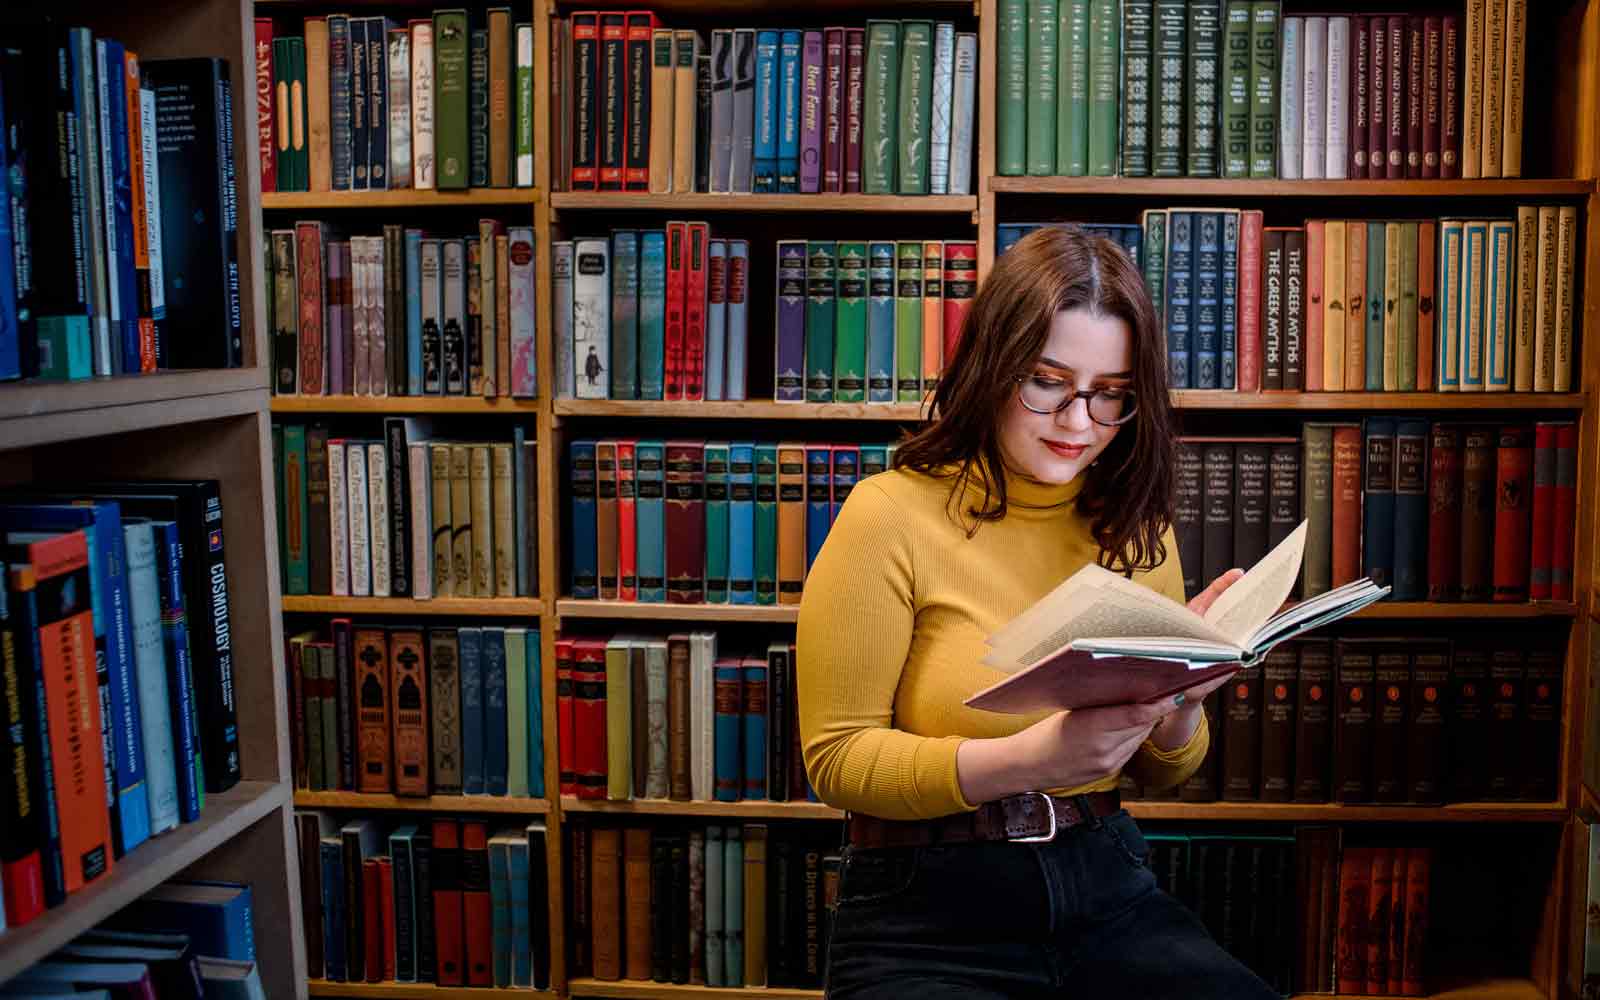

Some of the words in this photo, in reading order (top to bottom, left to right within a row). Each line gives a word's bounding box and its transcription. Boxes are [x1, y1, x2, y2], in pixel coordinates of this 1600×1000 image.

[1471, 2, 1482, 53] Byzantine
[1490, 1, 1500, 28] Early
[1231, 32, 1248, 71] 1914
[1256, 32, 1274, 71] 1917
[1358, 31, 1367, 72] MARVELS
[1374, 30, 1384, 66] HEROES
[1392, 30, 1401, 67] HISTORY
[1446, 30, 1456, 67] HISTORY
[353, 75, 364, 94] and
[370, 75, 382, 94] and
[786, 62, 794, 77] The
[807, 64, 820, 92] Brat
[829, 65, 839, 80] The
[850, 66, 860, 80] The
[1358, 73, 1367, 94] AND
[1374, 67, 1384, 89] AND
[1392, 69, 1401, 89] AND
[1411, 73, 1421, 94] AND
[1429, 67, 1439, 88] AND
[1446, 69, 1456, 89] AND
[1471, 73, 1480, 94] and
[1512, 59, 1521, 77] and
[256, 60, 271, 157] MOZART
[829, 81, 839, 114] Daughter
[850, 81, 860, 115] Daughter
[1358, 96, 1367, 127] MAGIC
[1374, 89, 1384, 123] SAINTS
[1392, 91, 1401, 137] ROMANCE
[1411, 96, 1421, 127] MAGIC
[1446, 91, 1456, 136] ROMANCE
[829, 126, 839, 144] Time
[850, 126, 860, 144] Time
[1231, 113, 1248, 154] 1916
[1256, 113, 1274, 154] 1919
[228, 180, 237, 232] UNIVERSE
[72, 215, 82, 258] Quantum
[1543, 216, 1554, 241] Early
[1562, 216, 1574, 266] Byzantine
[229, 263, 238, 290] SETH
[1268, 249, 1280, 274] THE
[1288, 249, 1300, 275] THE
[1544, 243, 1554, 286] Medieval
[1268, 277, 1280, 316] GREEK
[1288, 277, 1300, 315] GREEK
[1523, 273, 1532, 290] and
[1561, 289, 1570, 307] and
[231, 294, 240, 328] LLOYD
[1268, 317, 1280, 362] MYTHS
[1288, 317, 1300, 363] MYTHS
[1268, 368, 1280, 377] II
[210, 563, 231, 652] COSMOLOGY
[115, 608, 125, 663] PRIMORDIAL
[61, 623, 74, 683] Modern
[120, 666, 130, 704] DENSITY
[124, 705, 136, 773] PERTURBATION
